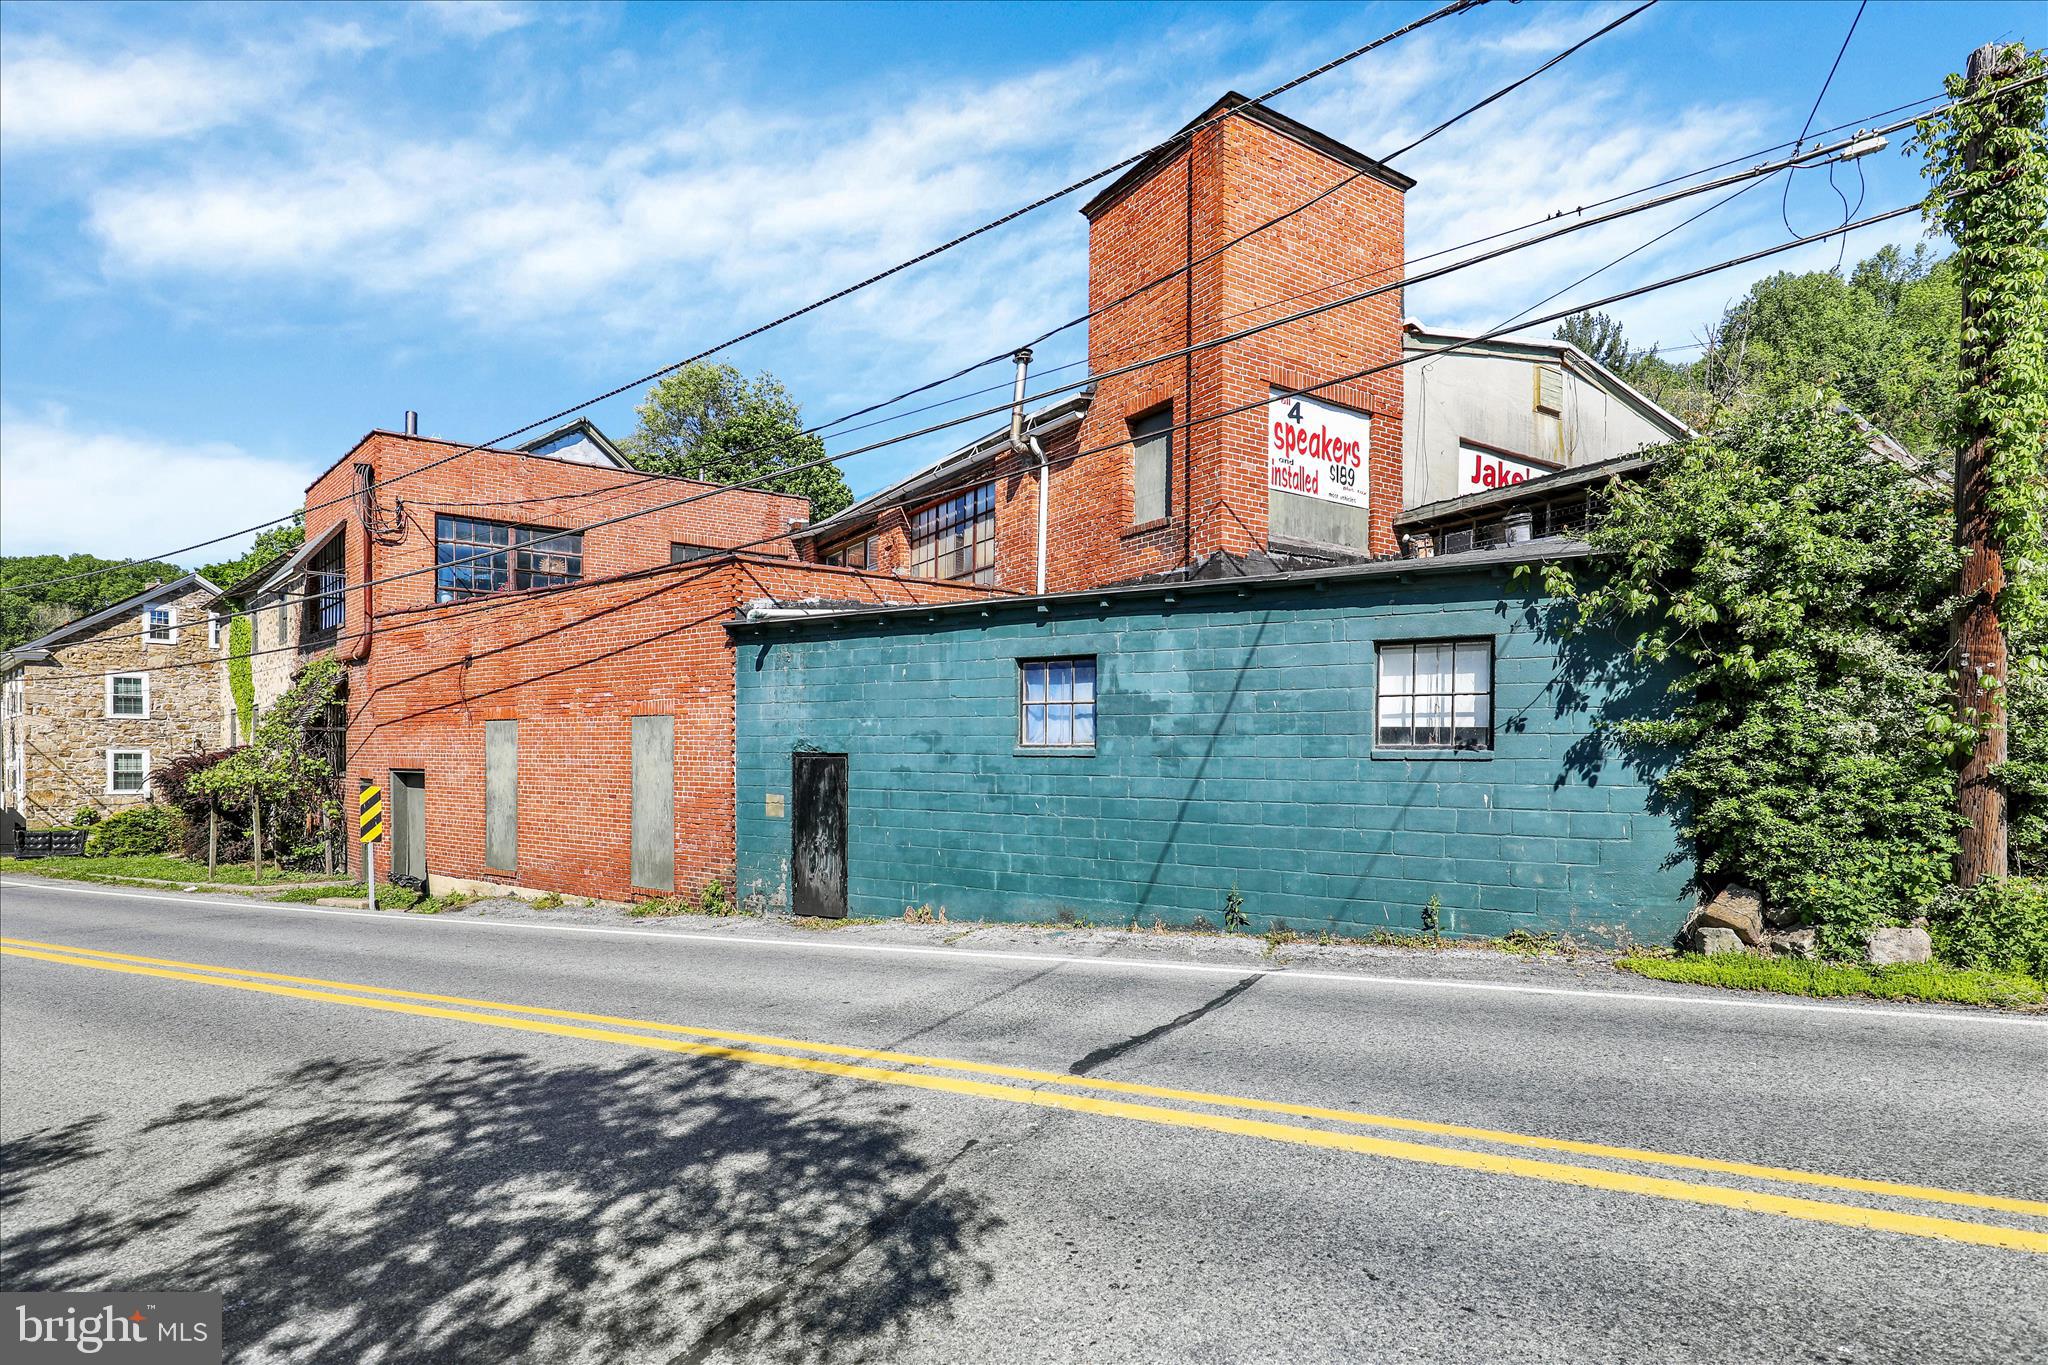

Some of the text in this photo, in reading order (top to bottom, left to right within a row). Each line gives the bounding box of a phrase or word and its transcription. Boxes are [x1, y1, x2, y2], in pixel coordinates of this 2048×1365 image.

[1287, 401, 1304, 424] 4
[1274, 422, 1361, 468] speakers
[1278, 457, 1294, 465] and
[1471, 455, 1532, 488] Jake'
[1271, 457, 1319, 495] installed
[1329, 464, 1355, 487] $189
